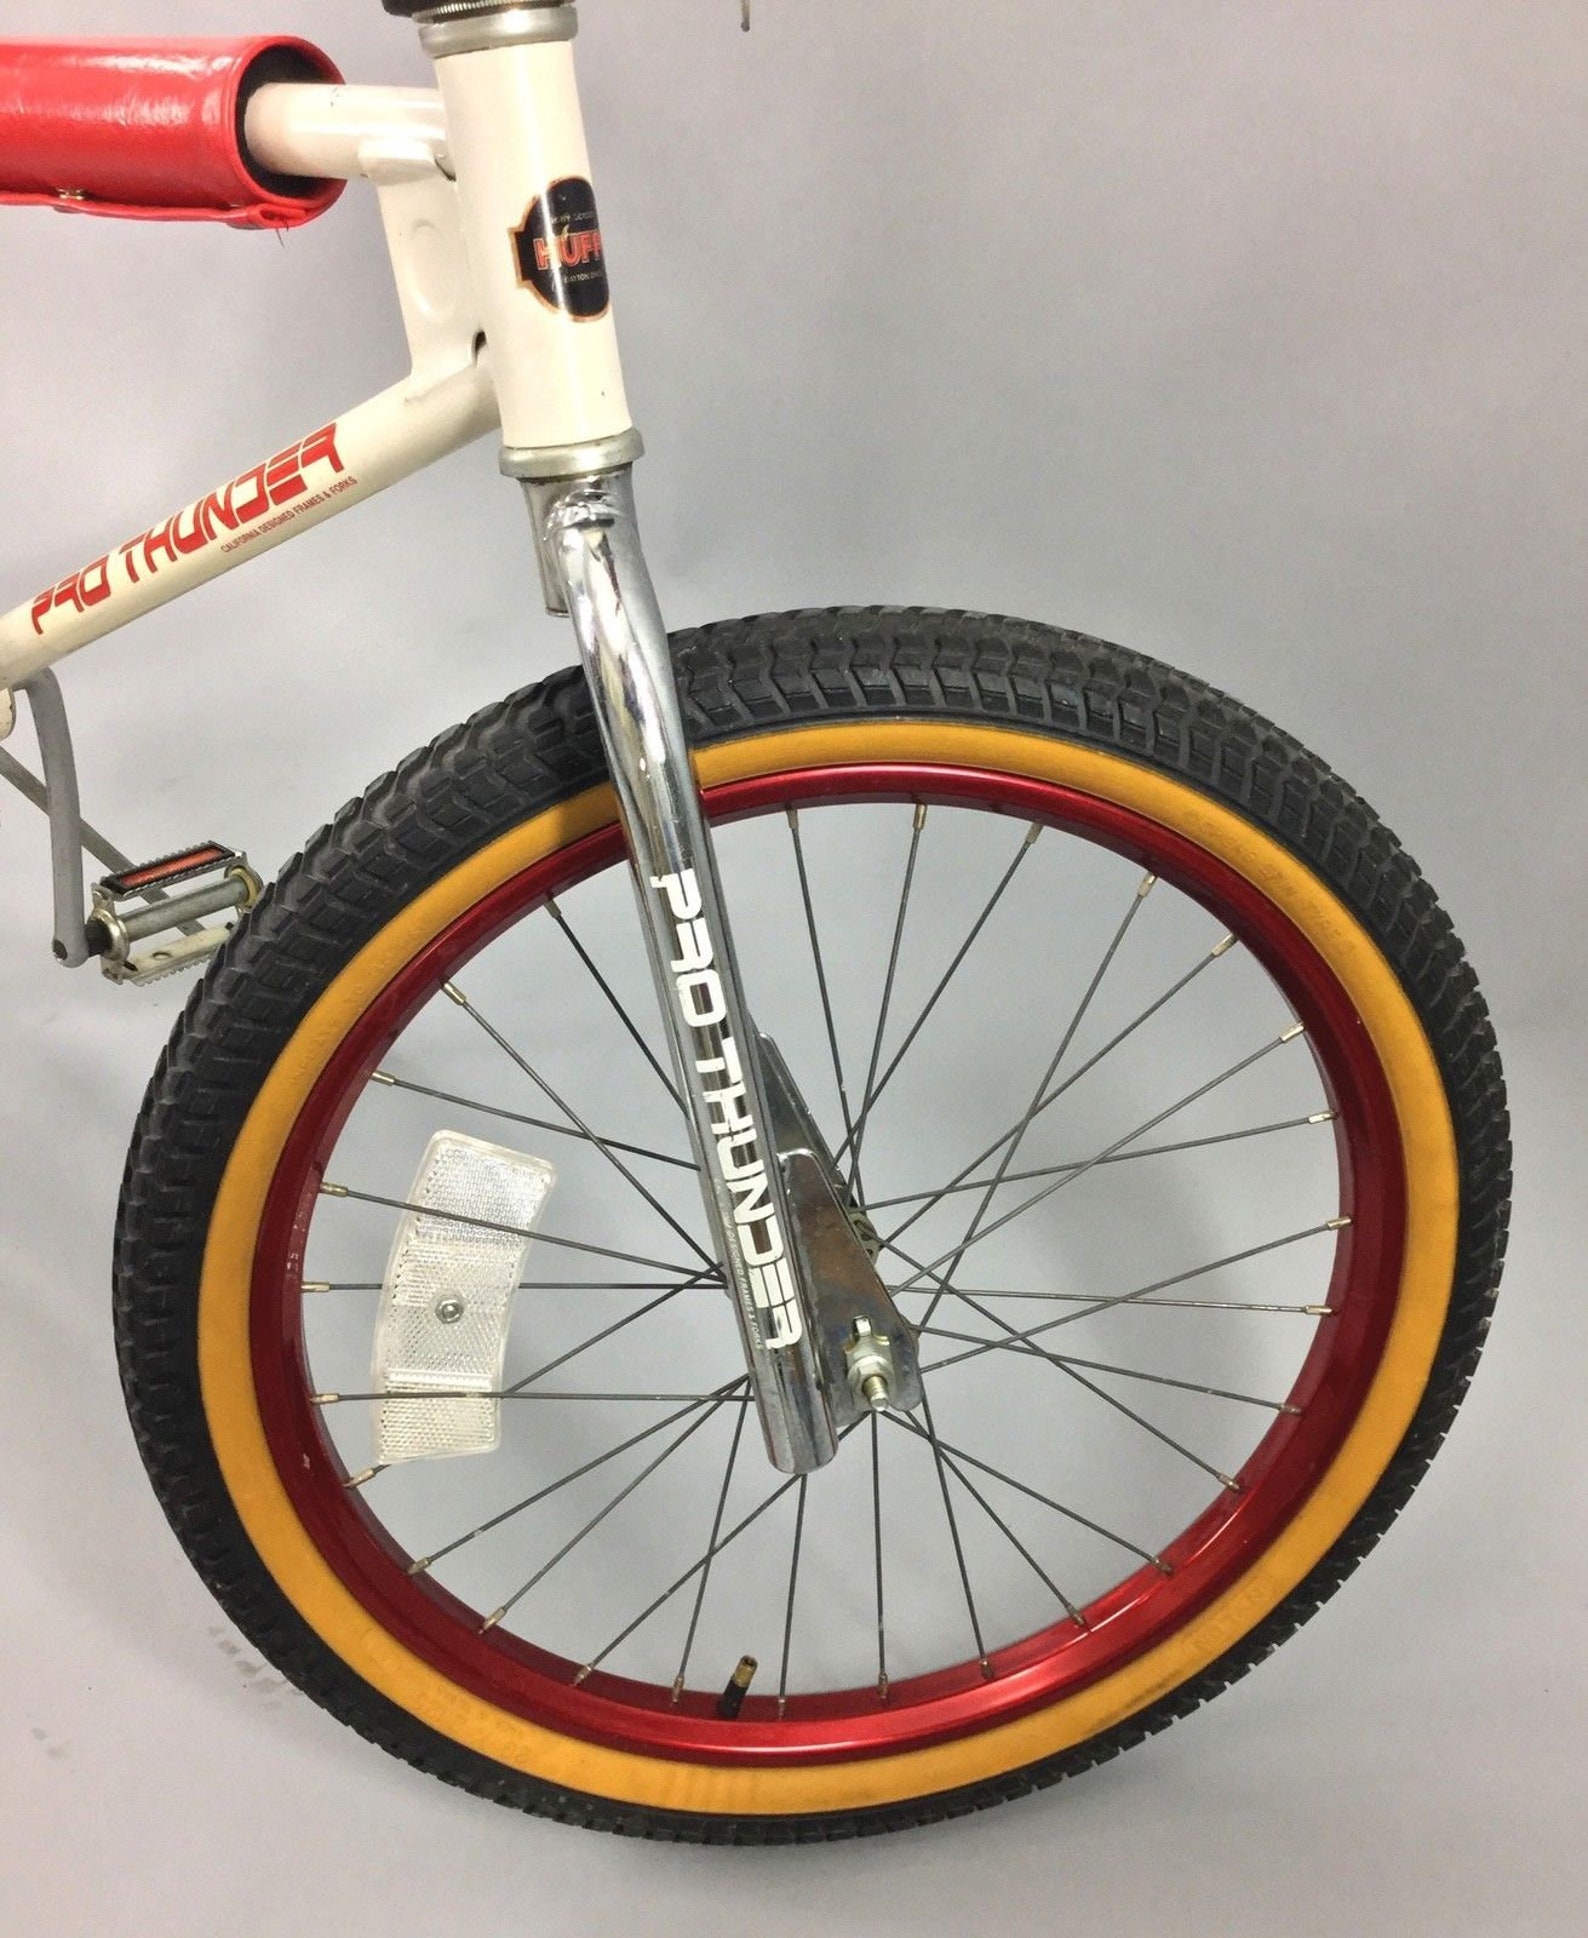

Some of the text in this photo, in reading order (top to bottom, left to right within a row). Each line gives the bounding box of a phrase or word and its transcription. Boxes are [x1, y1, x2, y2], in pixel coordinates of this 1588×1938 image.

[31, 422, 345, 635] PRO THUNDER
[220, 529, 262, 553] CALIFORNIA
[261, 510, 296, 533] DESIGNED
[292, 494, 326, 515] FRAMES
[329, 476, 358, 497] FORKS
[650, 868, 802, 1350] PRO THUNDER
